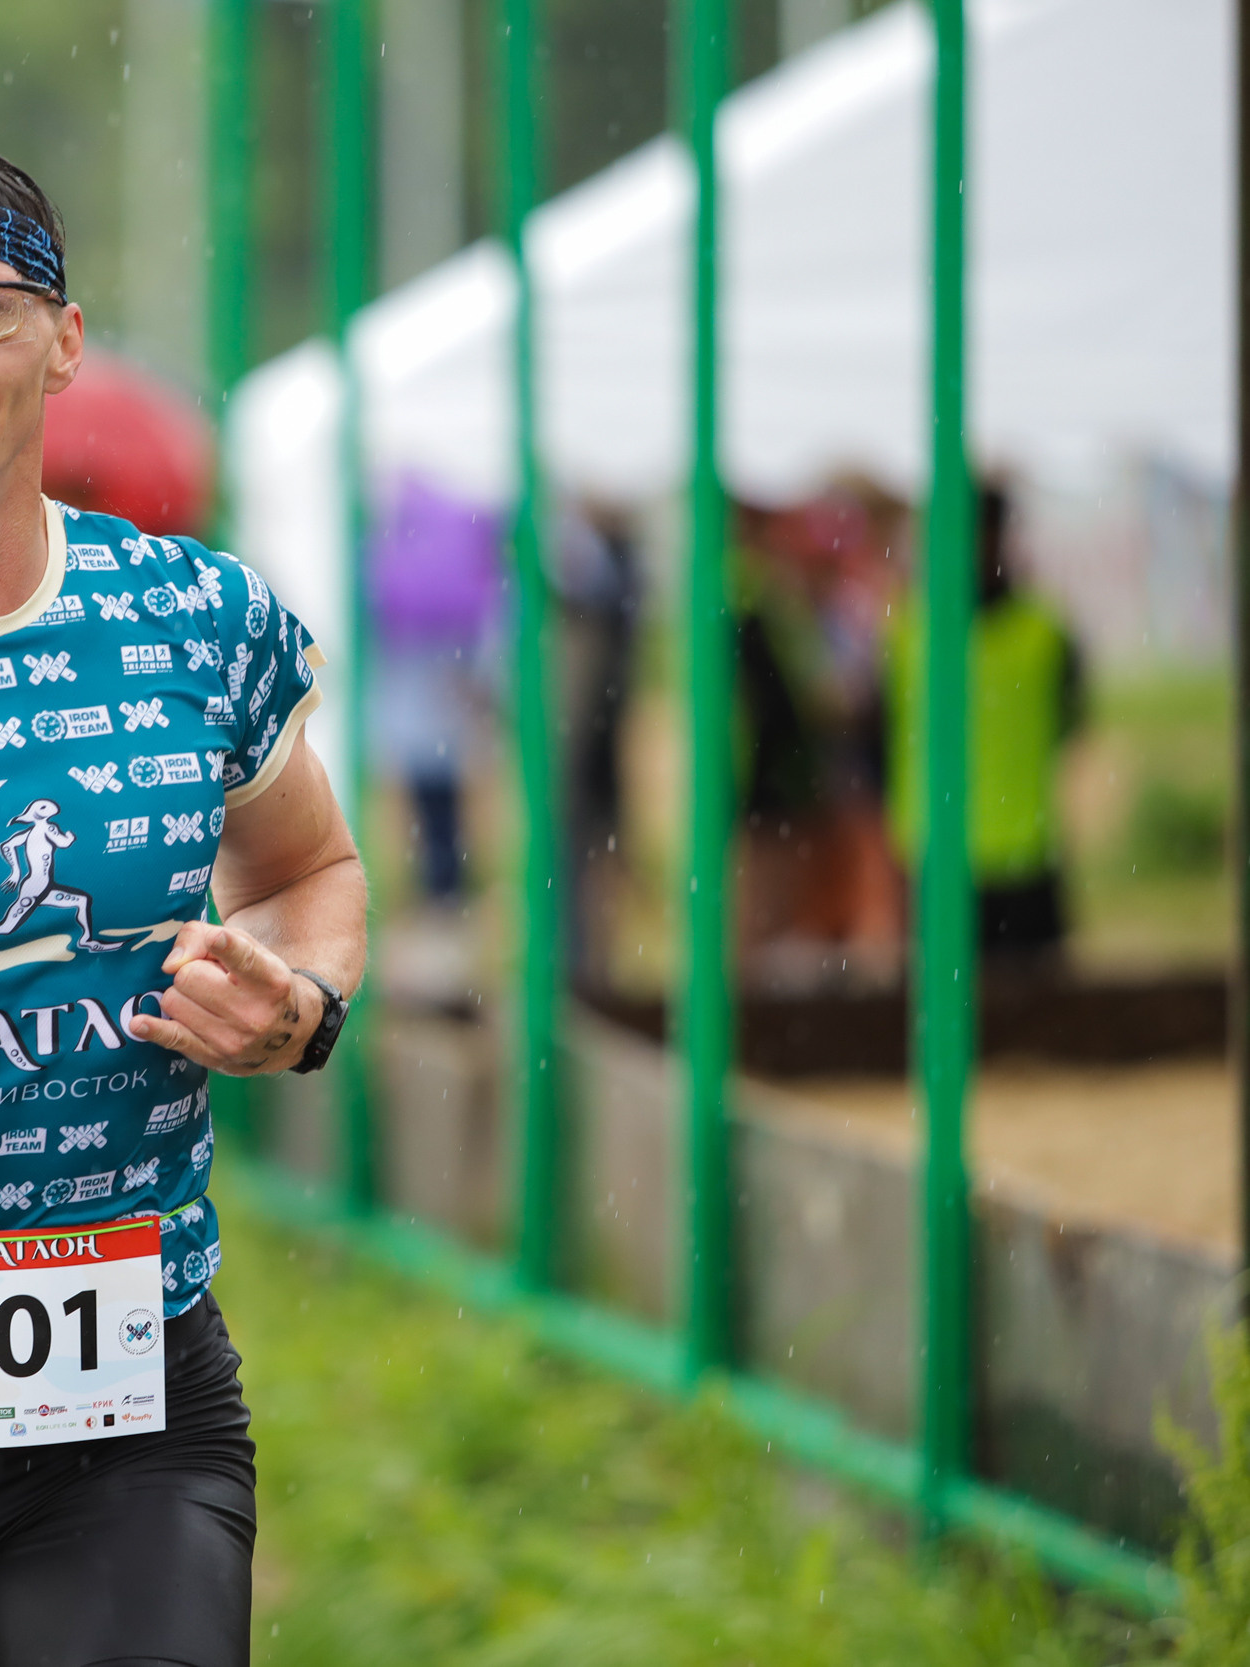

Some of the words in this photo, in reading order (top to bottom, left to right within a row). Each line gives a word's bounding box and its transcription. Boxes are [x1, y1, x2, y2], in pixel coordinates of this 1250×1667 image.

[78, 547, 104, 558] IRON
[83, 559, 115, 569] TEAM
[123, 661, 173, 670] TRIATHLON
[69, 711, 100, 723] IRON
[72, 723, 108, 734] TEAM
[164, 757, 192, 768] IRON
[168, 769, 200, 781] TEAM
[5, 1128, 37, 1139] IRON
[5, 1142, 42, 1152] TEAM
[80, 1175, 109, 1188] IRON
[79, 1186, 110, 1199] TEAM
